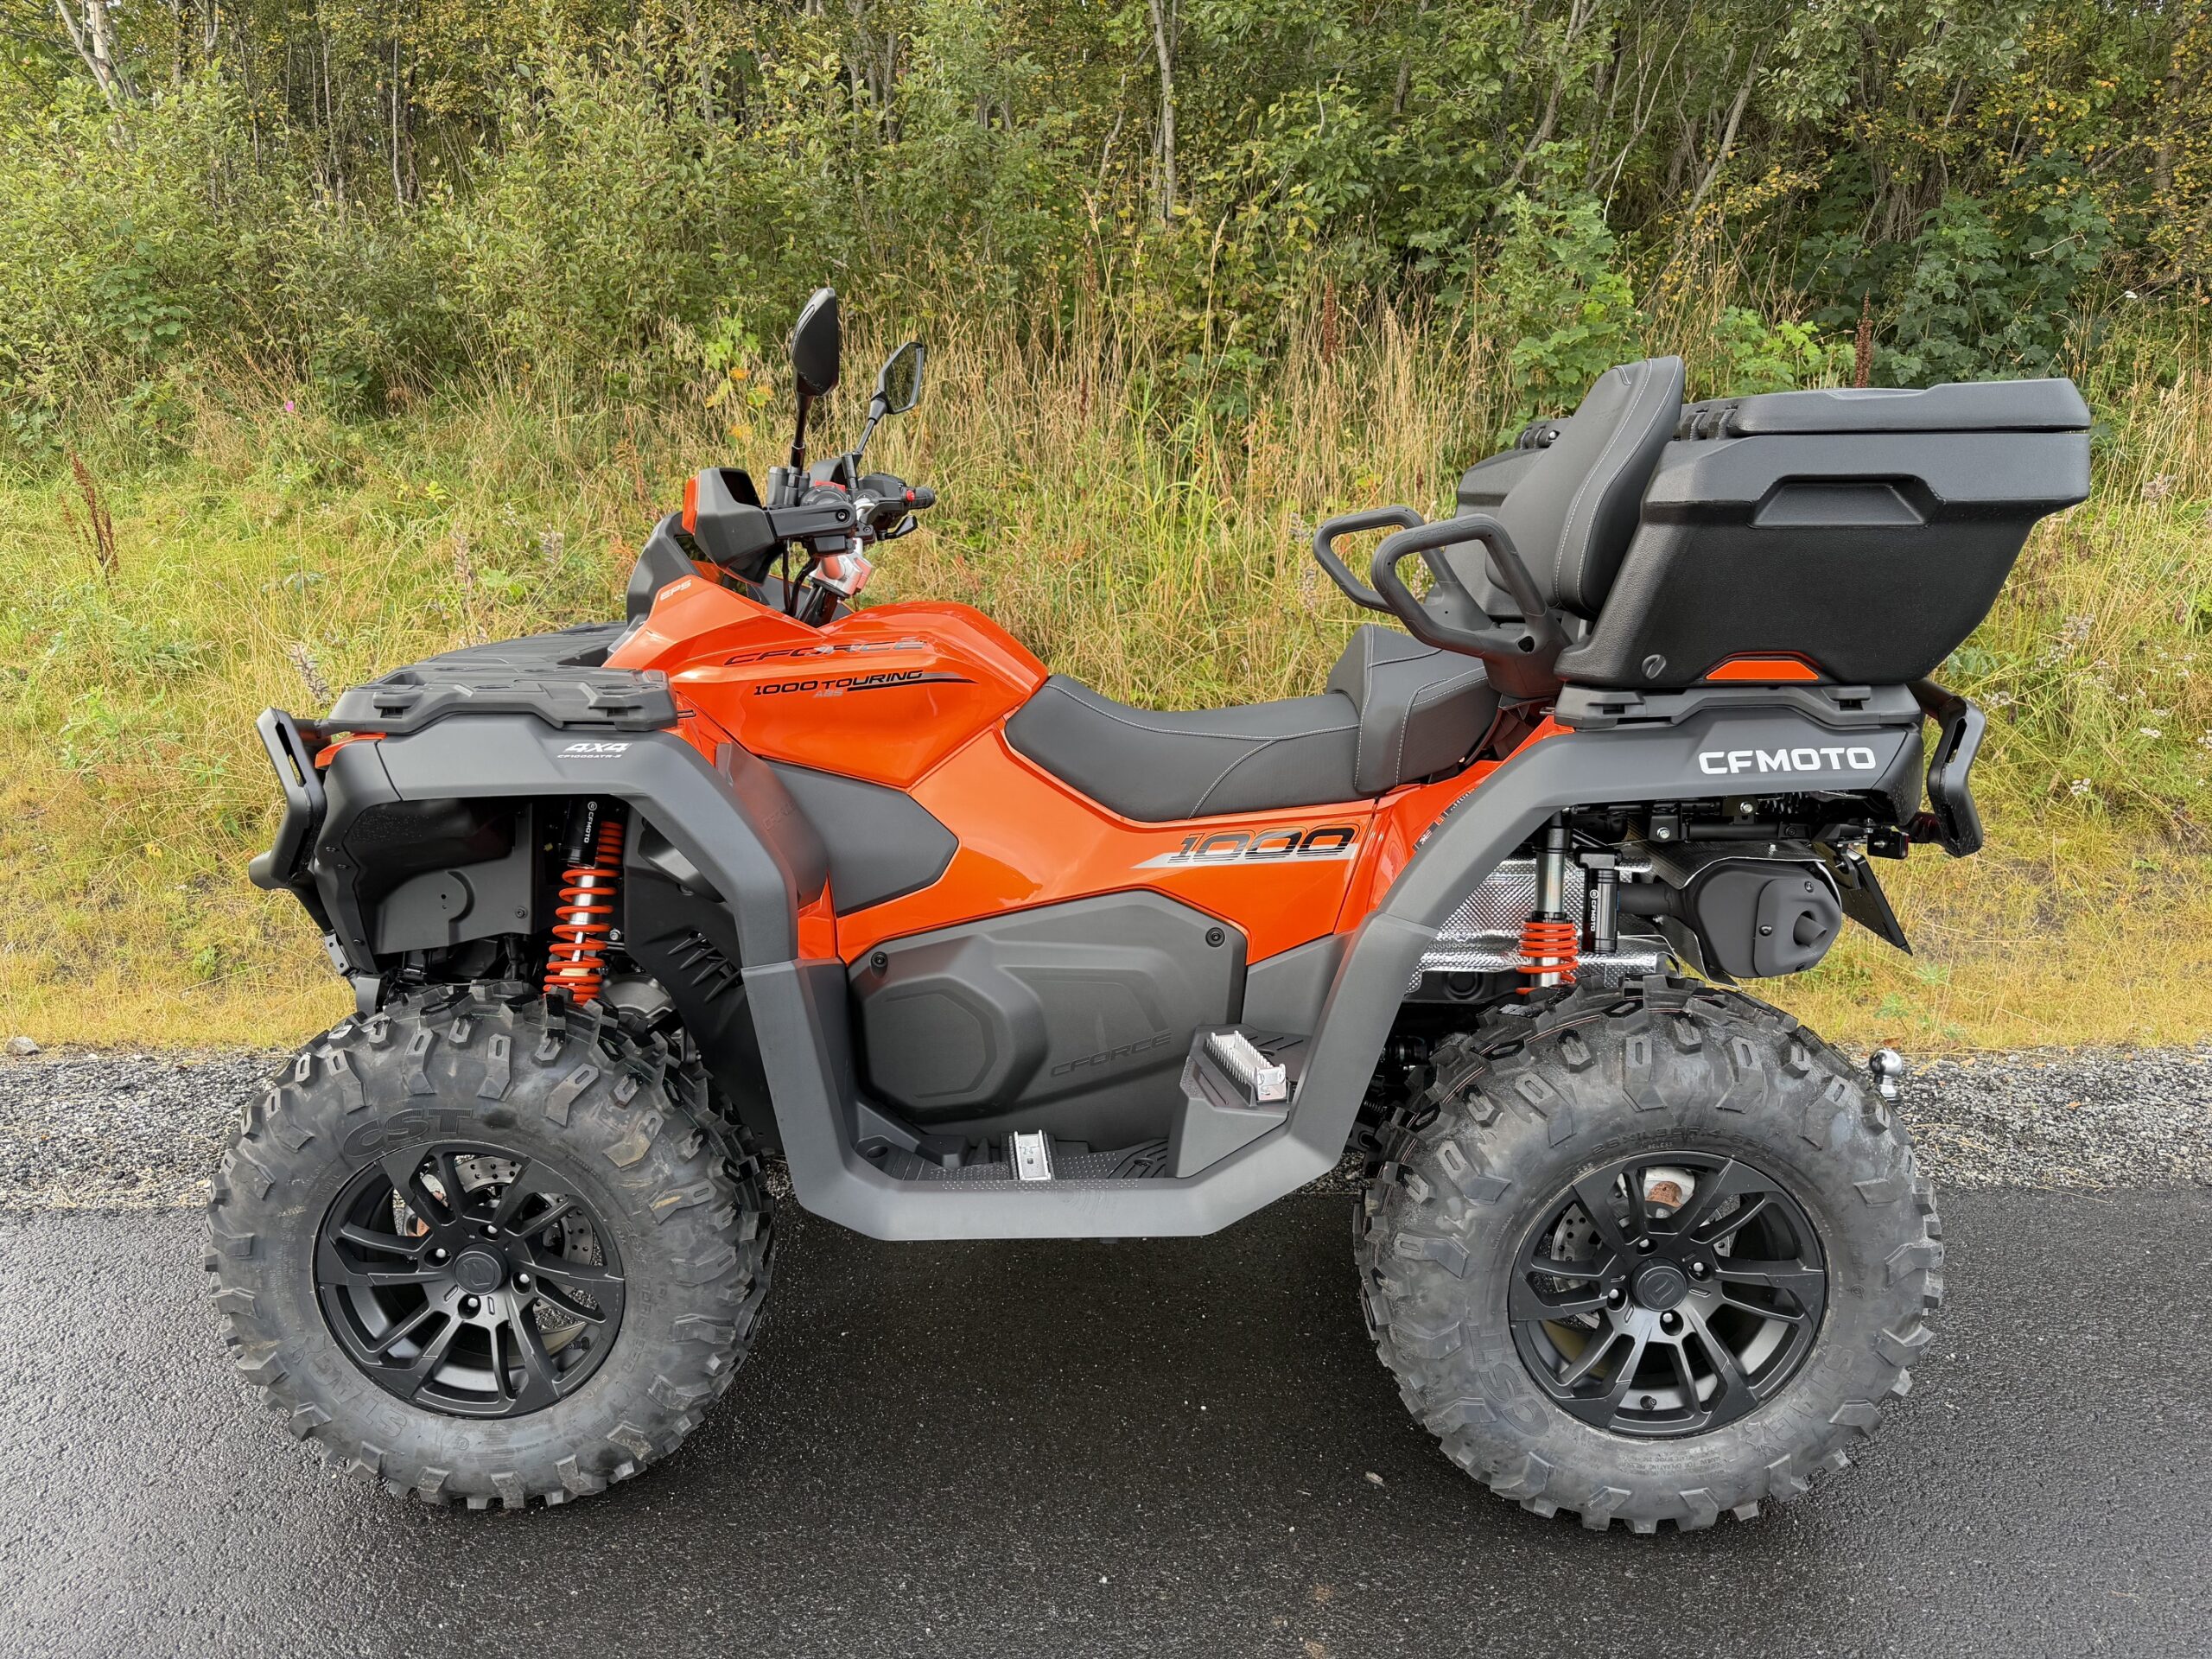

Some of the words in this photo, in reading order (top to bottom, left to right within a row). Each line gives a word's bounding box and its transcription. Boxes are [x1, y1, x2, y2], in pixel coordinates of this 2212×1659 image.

[659, 579, 692, 601] EPS
[723, 638, 928, 666] CFORCE
[753, 680, 819, 696] 1000
[821, 670, 924, 690] TOURING
[813, 689, 844, 698] ABS
[563, 742, 632, 753] 4X4
[1698, 747, 1877, 775] CFMOTO
[583, 811, 594, 843] CFMOTO
[1167, 823, 1360, 863] 1000
[1051, 1028, 1173, 1077] CFORCE
[343, 1107, 474, 1159] CST
[1467, 1324, 1551, 1437] CST
